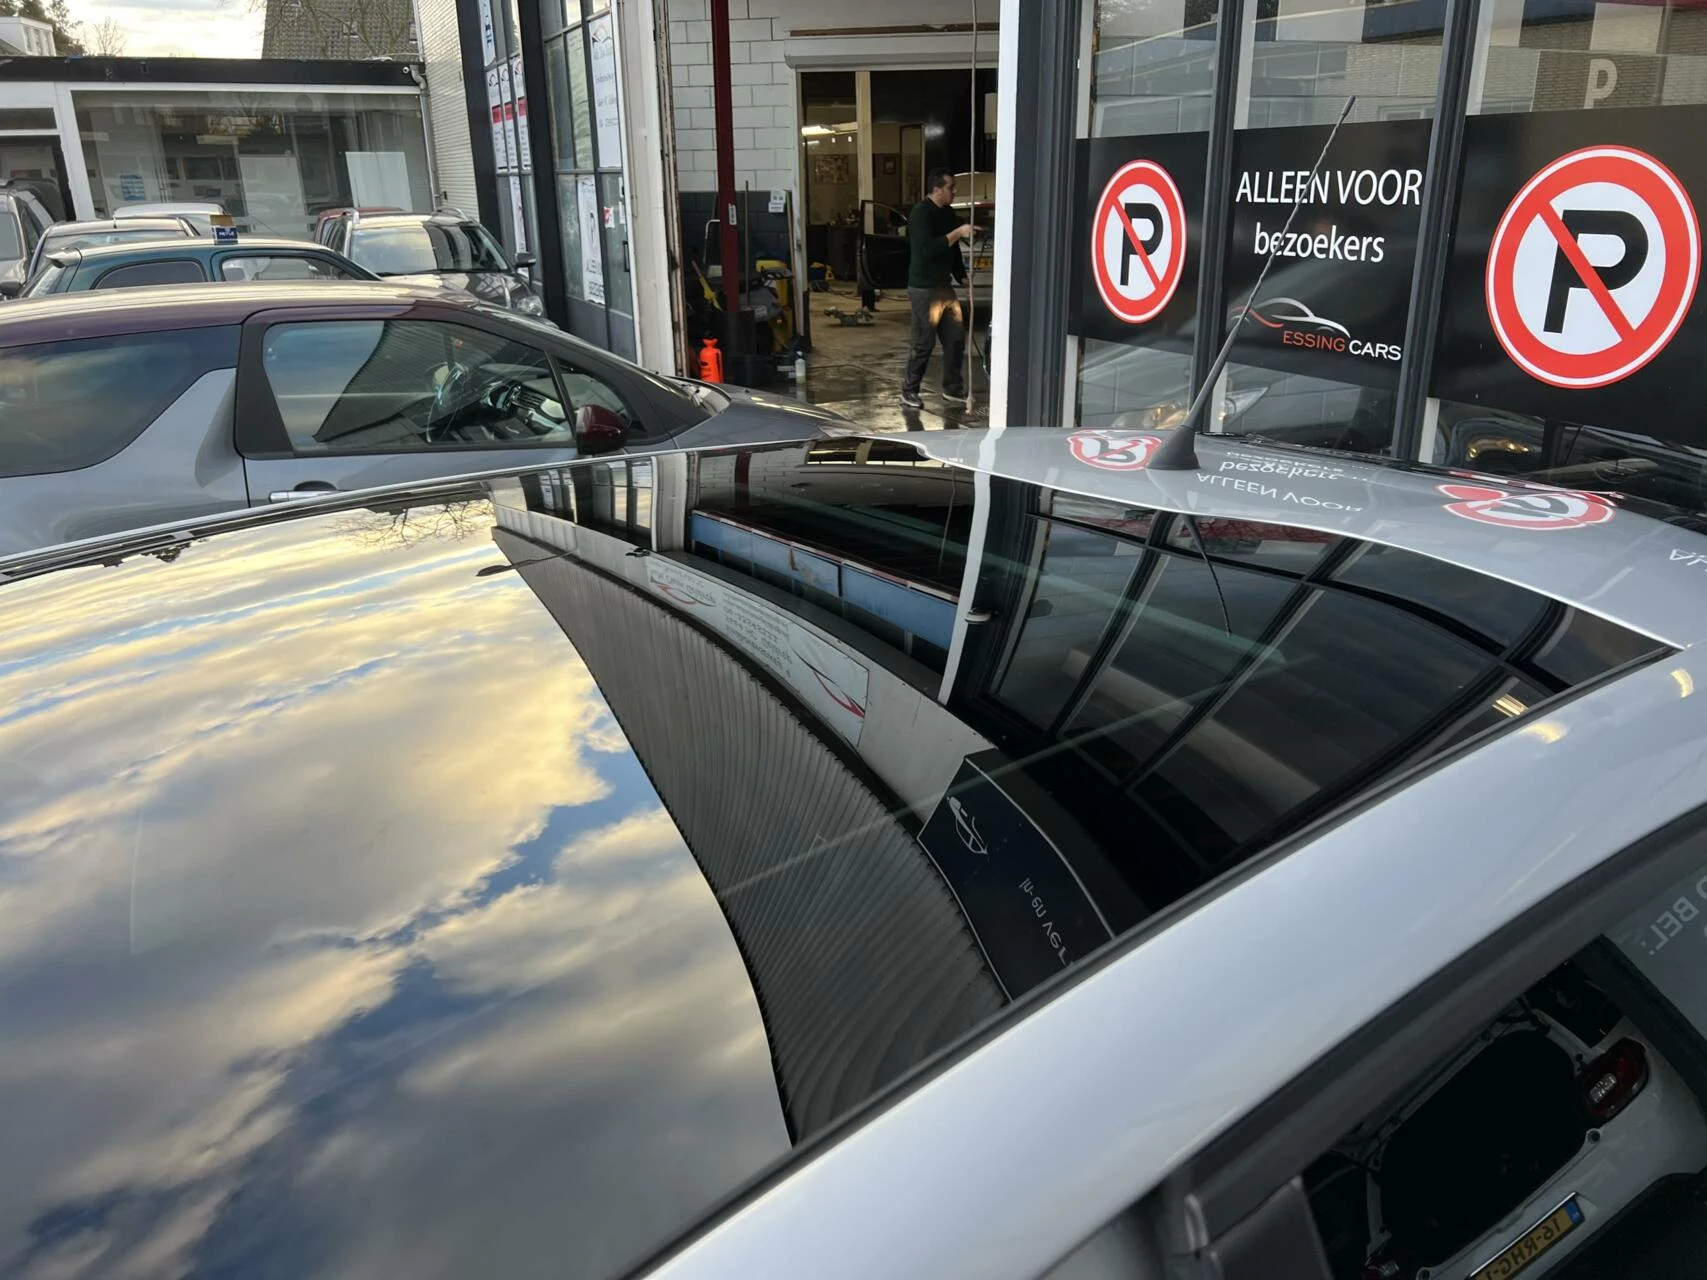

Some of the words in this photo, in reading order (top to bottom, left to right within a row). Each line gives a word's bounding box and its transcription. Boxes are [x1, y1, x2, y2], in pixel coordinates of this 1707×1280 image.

[1235, 170, 1331, 205] ALLEEN
[1336, 168, 1424, 206] VOOR
[1254, 221, 1386, 264] bezoekers
[1283, 330, 1346, 353] ESSING
[1348, 339, 1402, 361] CARS
